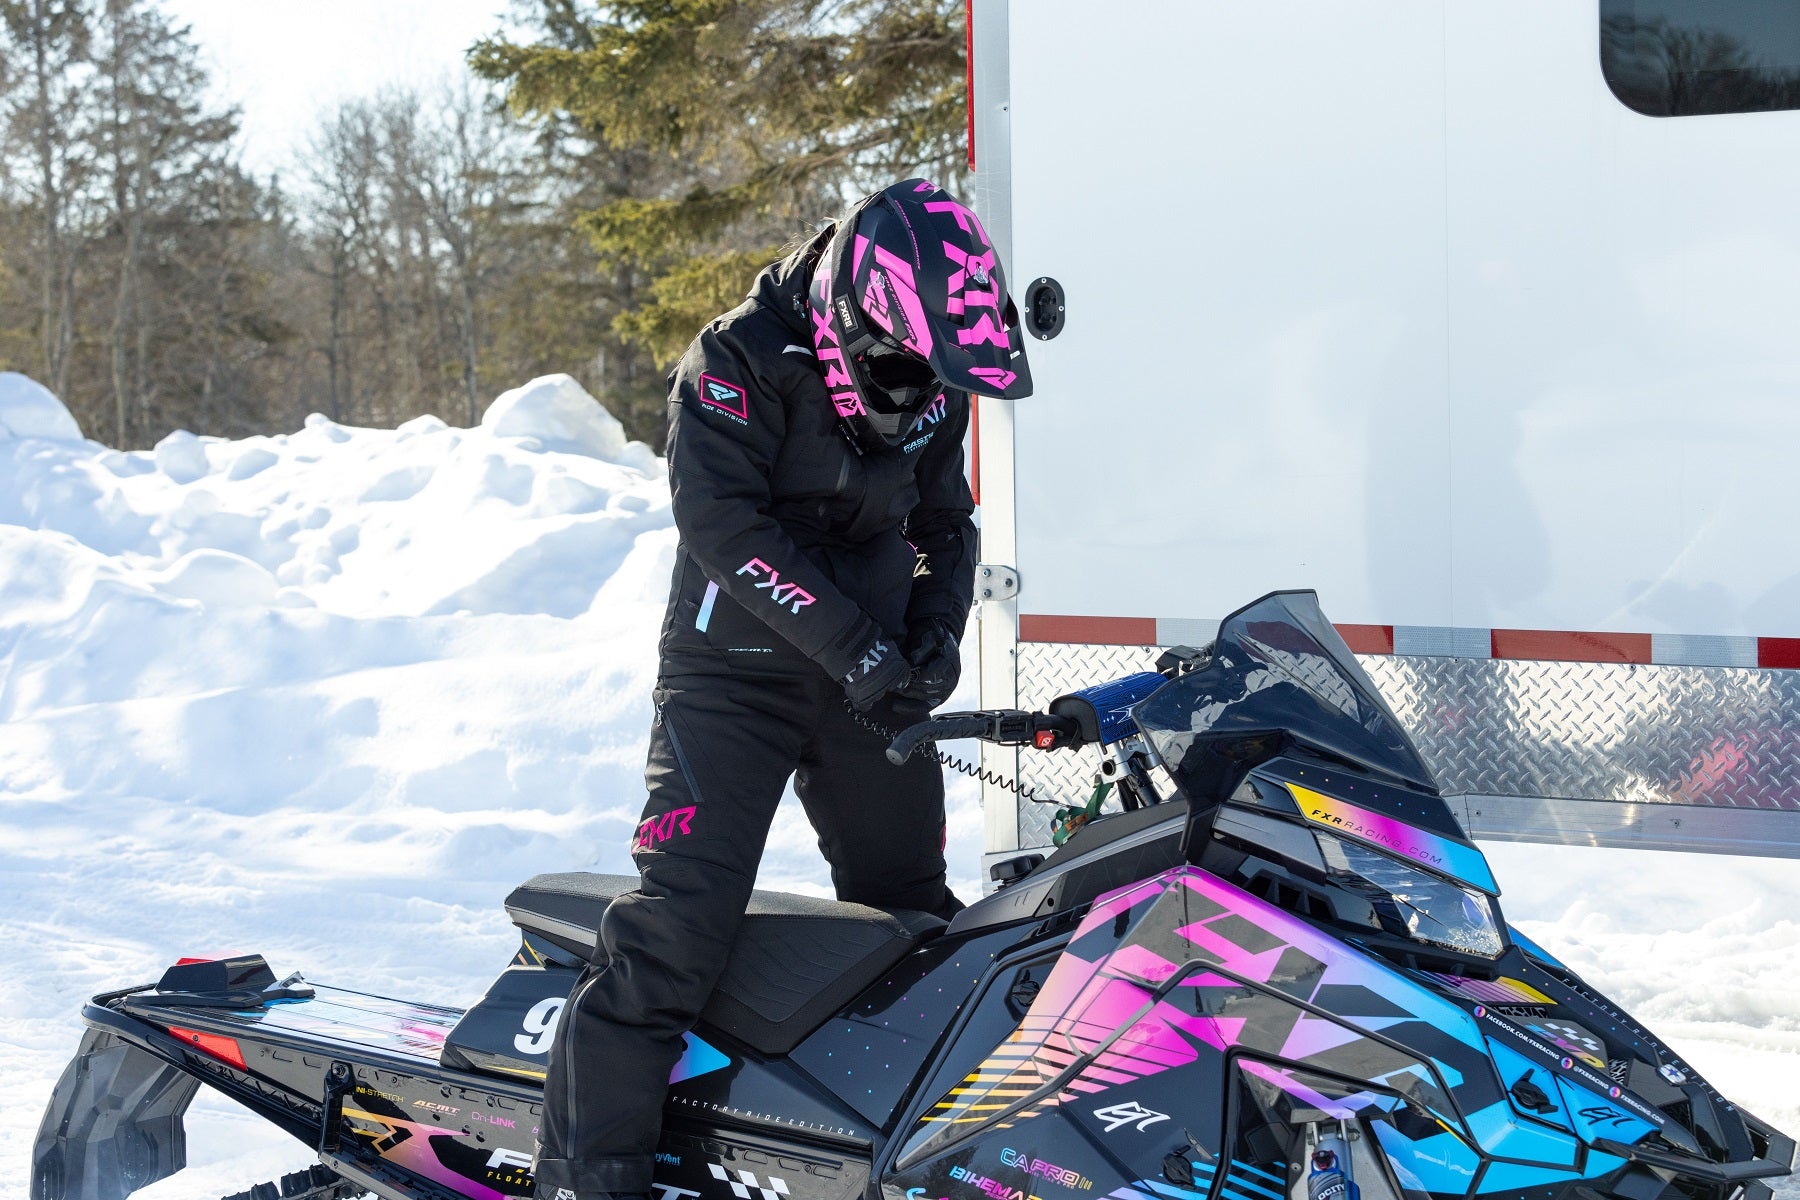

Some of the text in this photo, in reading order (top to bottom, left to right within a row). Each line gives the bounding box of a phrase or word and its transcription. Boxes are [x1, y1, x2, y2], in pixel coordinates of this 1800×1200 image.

[735, 556, 817, 615] FXR
[631, 805, 697, 855] FXR
[1561, 977, 1628, 1025] FACTORY
[355, 1085, 404, 1102] NI-STRETCH
[672, 1096, 856, 1136] FACTORY RIDE EDITION
[486, 1171, 532, 1187] FLOAT
[1318, 1182, 1346, 1200] OCITY
